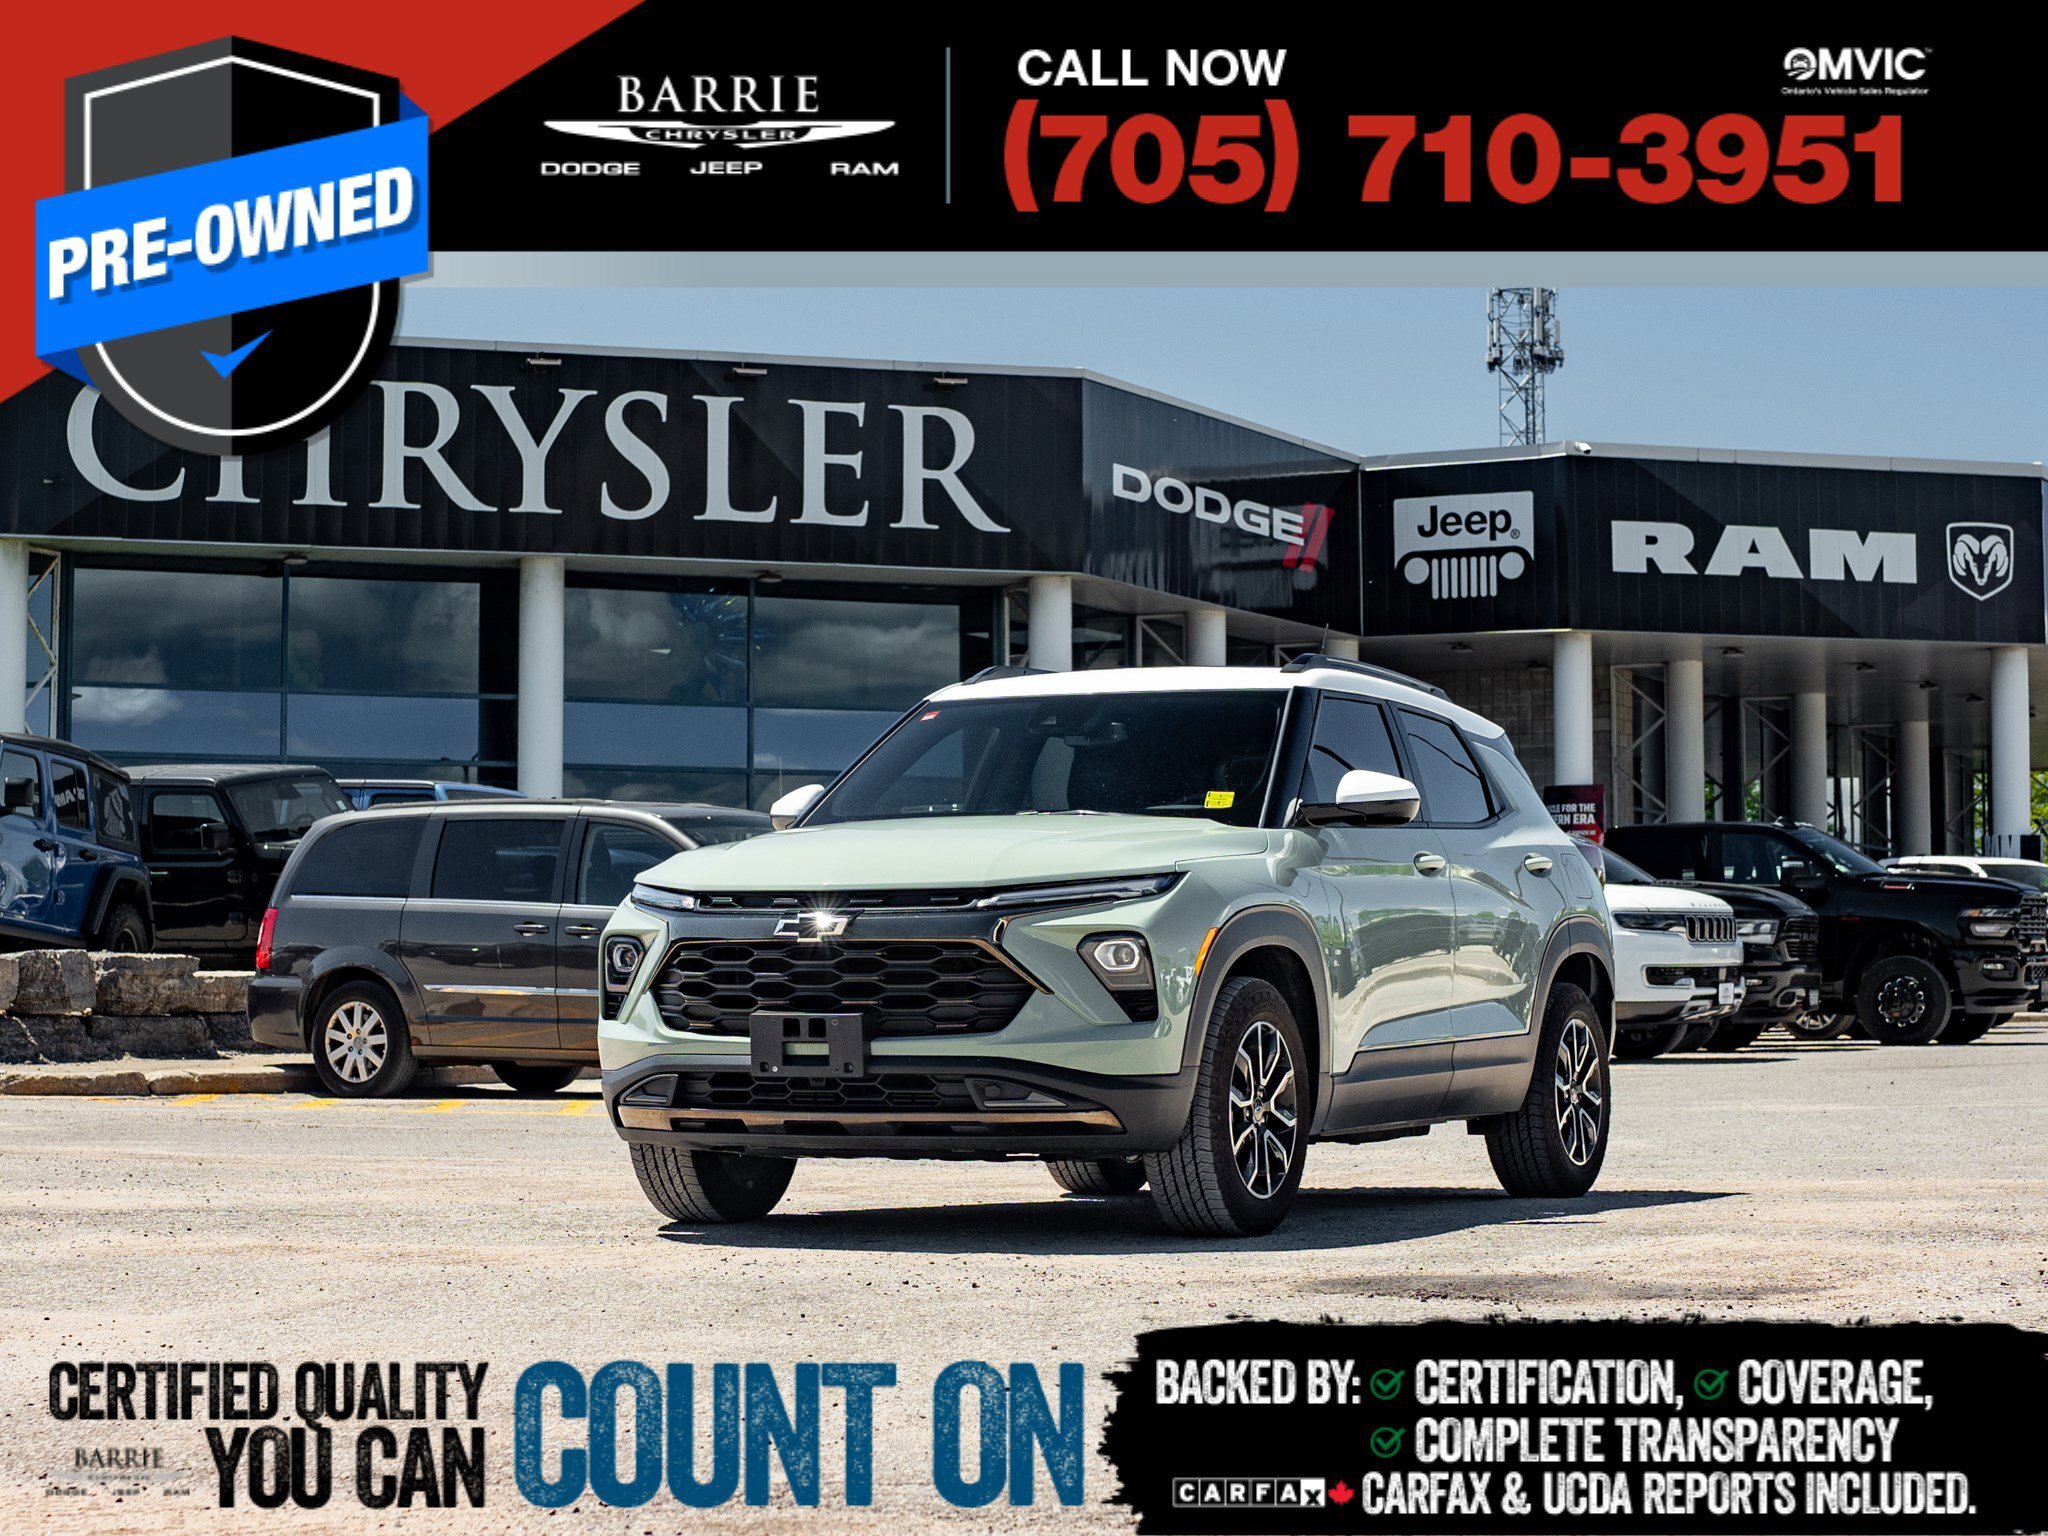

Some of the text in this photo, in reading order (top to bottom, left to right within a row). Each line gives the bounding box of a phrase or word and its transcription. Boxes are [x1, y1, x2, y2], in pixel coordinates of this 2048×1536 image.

[1112, 462, 1305, 546] DODGE
[1417, 503, 1512, 541] Jeep
[1610, 520, 1918, 584] RAM
[1561, 803, 1578, 813] FOR
[1578, 803, 1596, 812] THE
[1573, 813, 1596, 825] ERA
